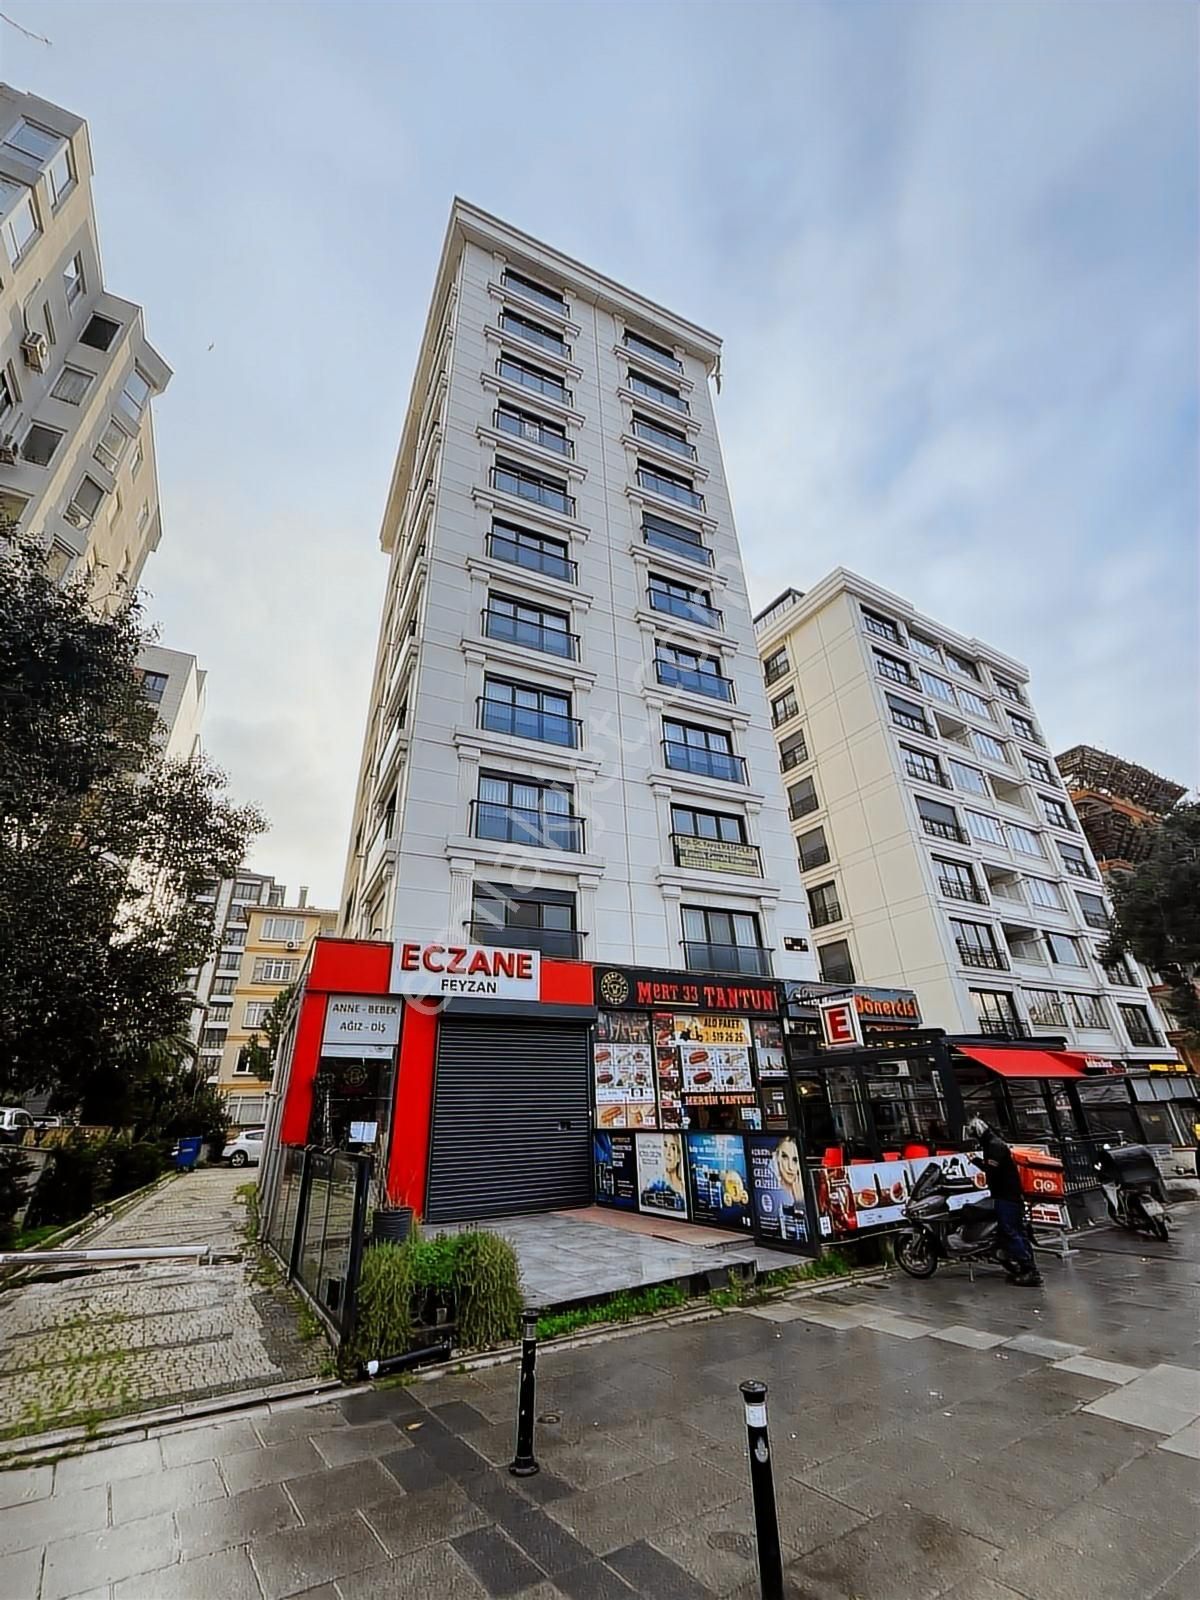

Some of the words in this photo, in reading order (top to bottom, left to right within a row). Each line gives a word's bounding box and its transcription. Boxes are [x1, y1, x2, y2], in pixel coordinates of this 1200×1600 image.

[400, 943, 533, 980] ECZANE
[440, 978, 498, 994] FEYZAN
[683, 987, 699, 1001] 33
[332, 1003, 361, 1014] ANNE
[367, 1004, 397, 1015] BEBEK
[339, 1020, 363, 1031] AĞIZ
[370, 1021, 386, 1033] DİŞ
[827, 1006, 853, 1040] E
